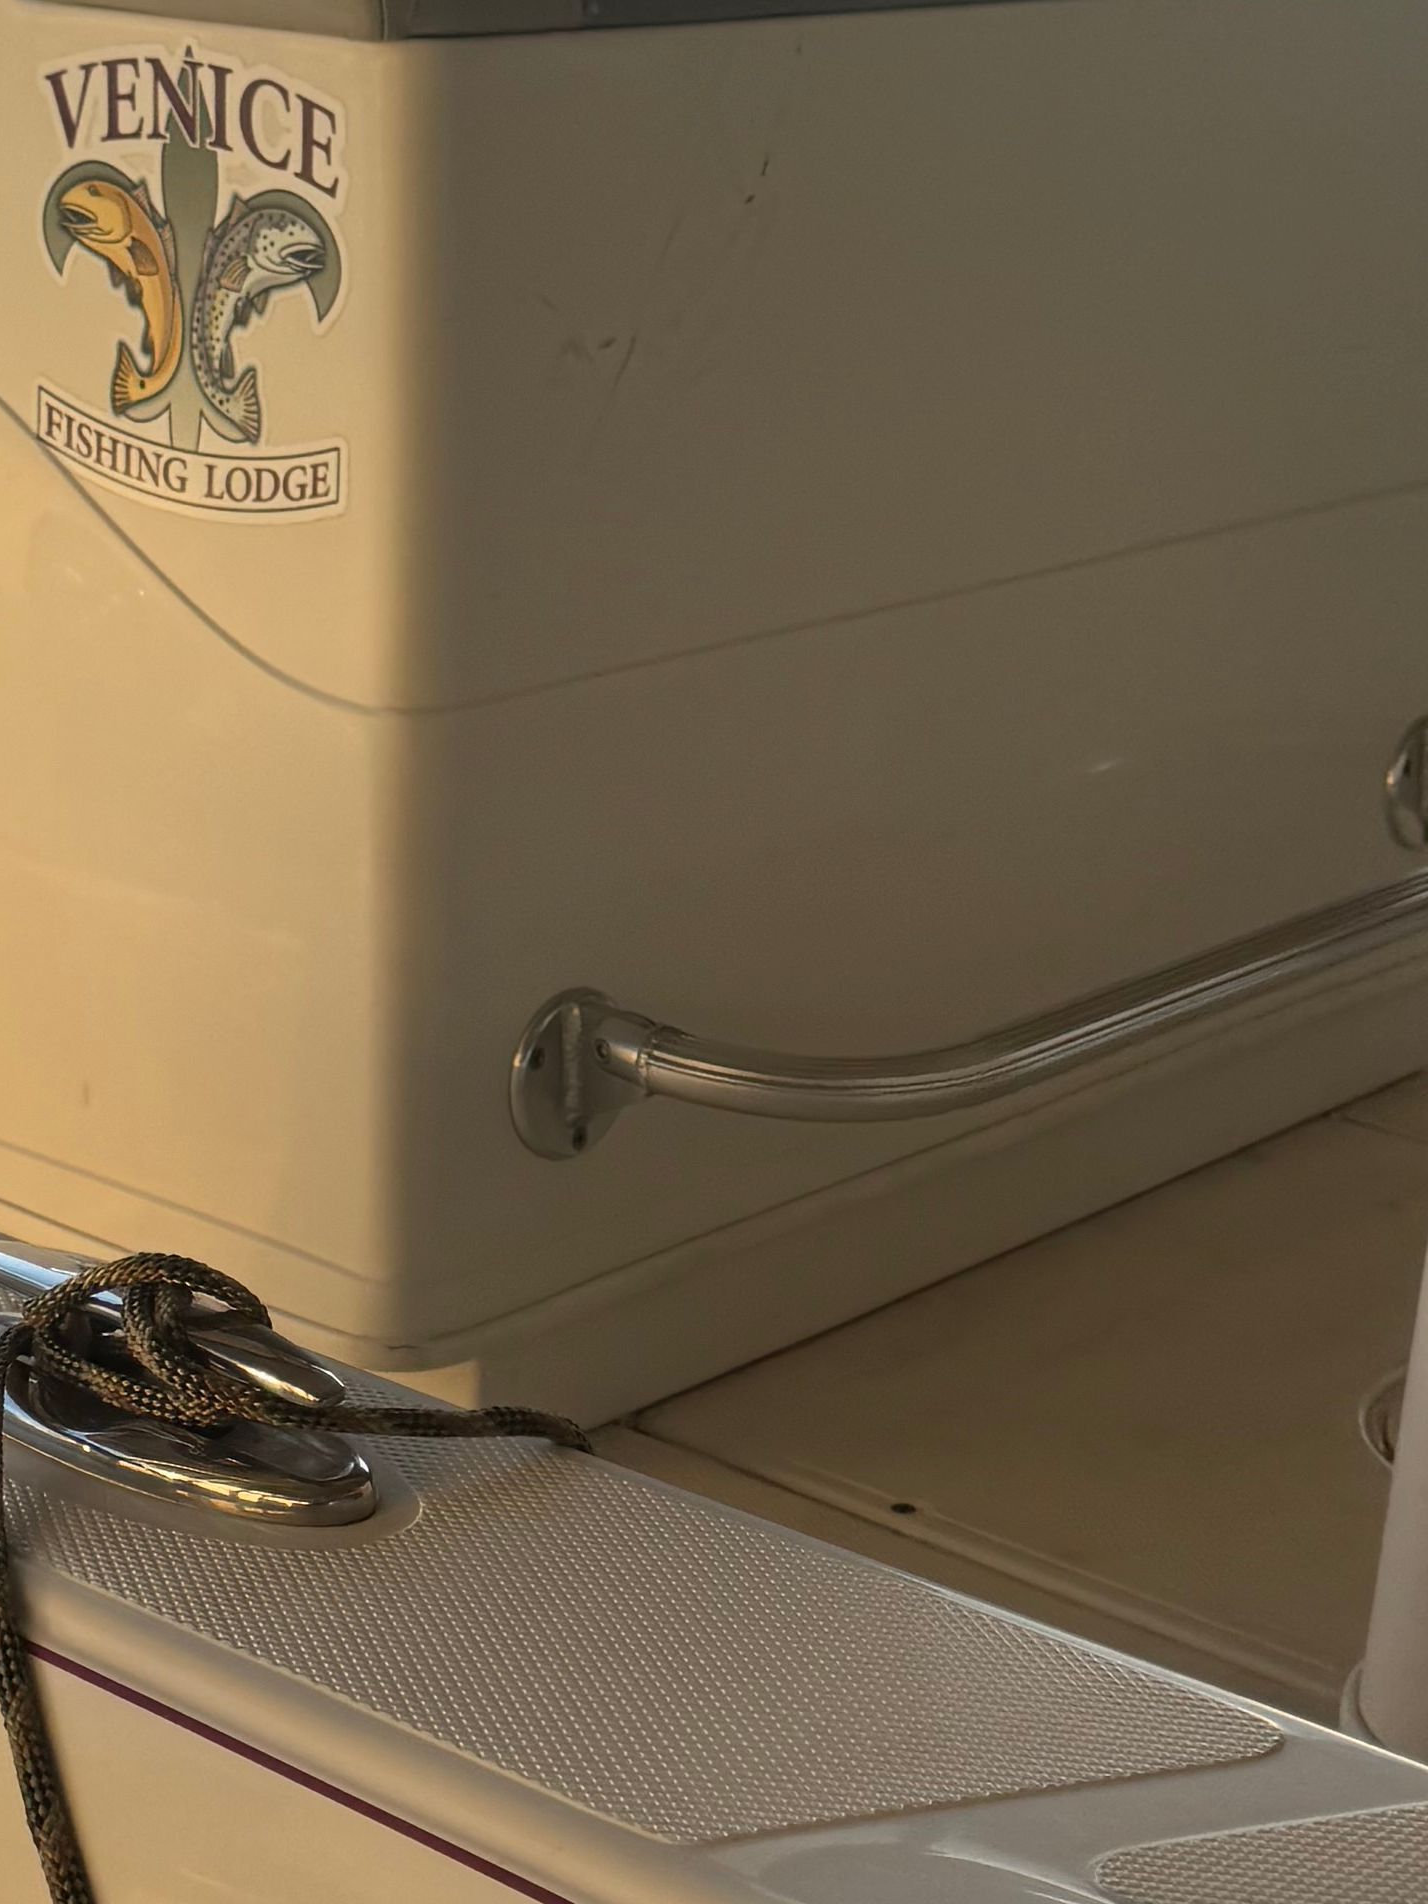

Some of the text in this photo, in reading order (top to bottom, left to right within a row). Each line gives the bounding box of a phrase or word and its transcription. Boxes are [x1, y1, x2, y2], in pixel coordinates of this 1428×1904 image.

[44, 57, 340, 198] VENICE
[45, 401, 332, 503] FISHING LODGE
